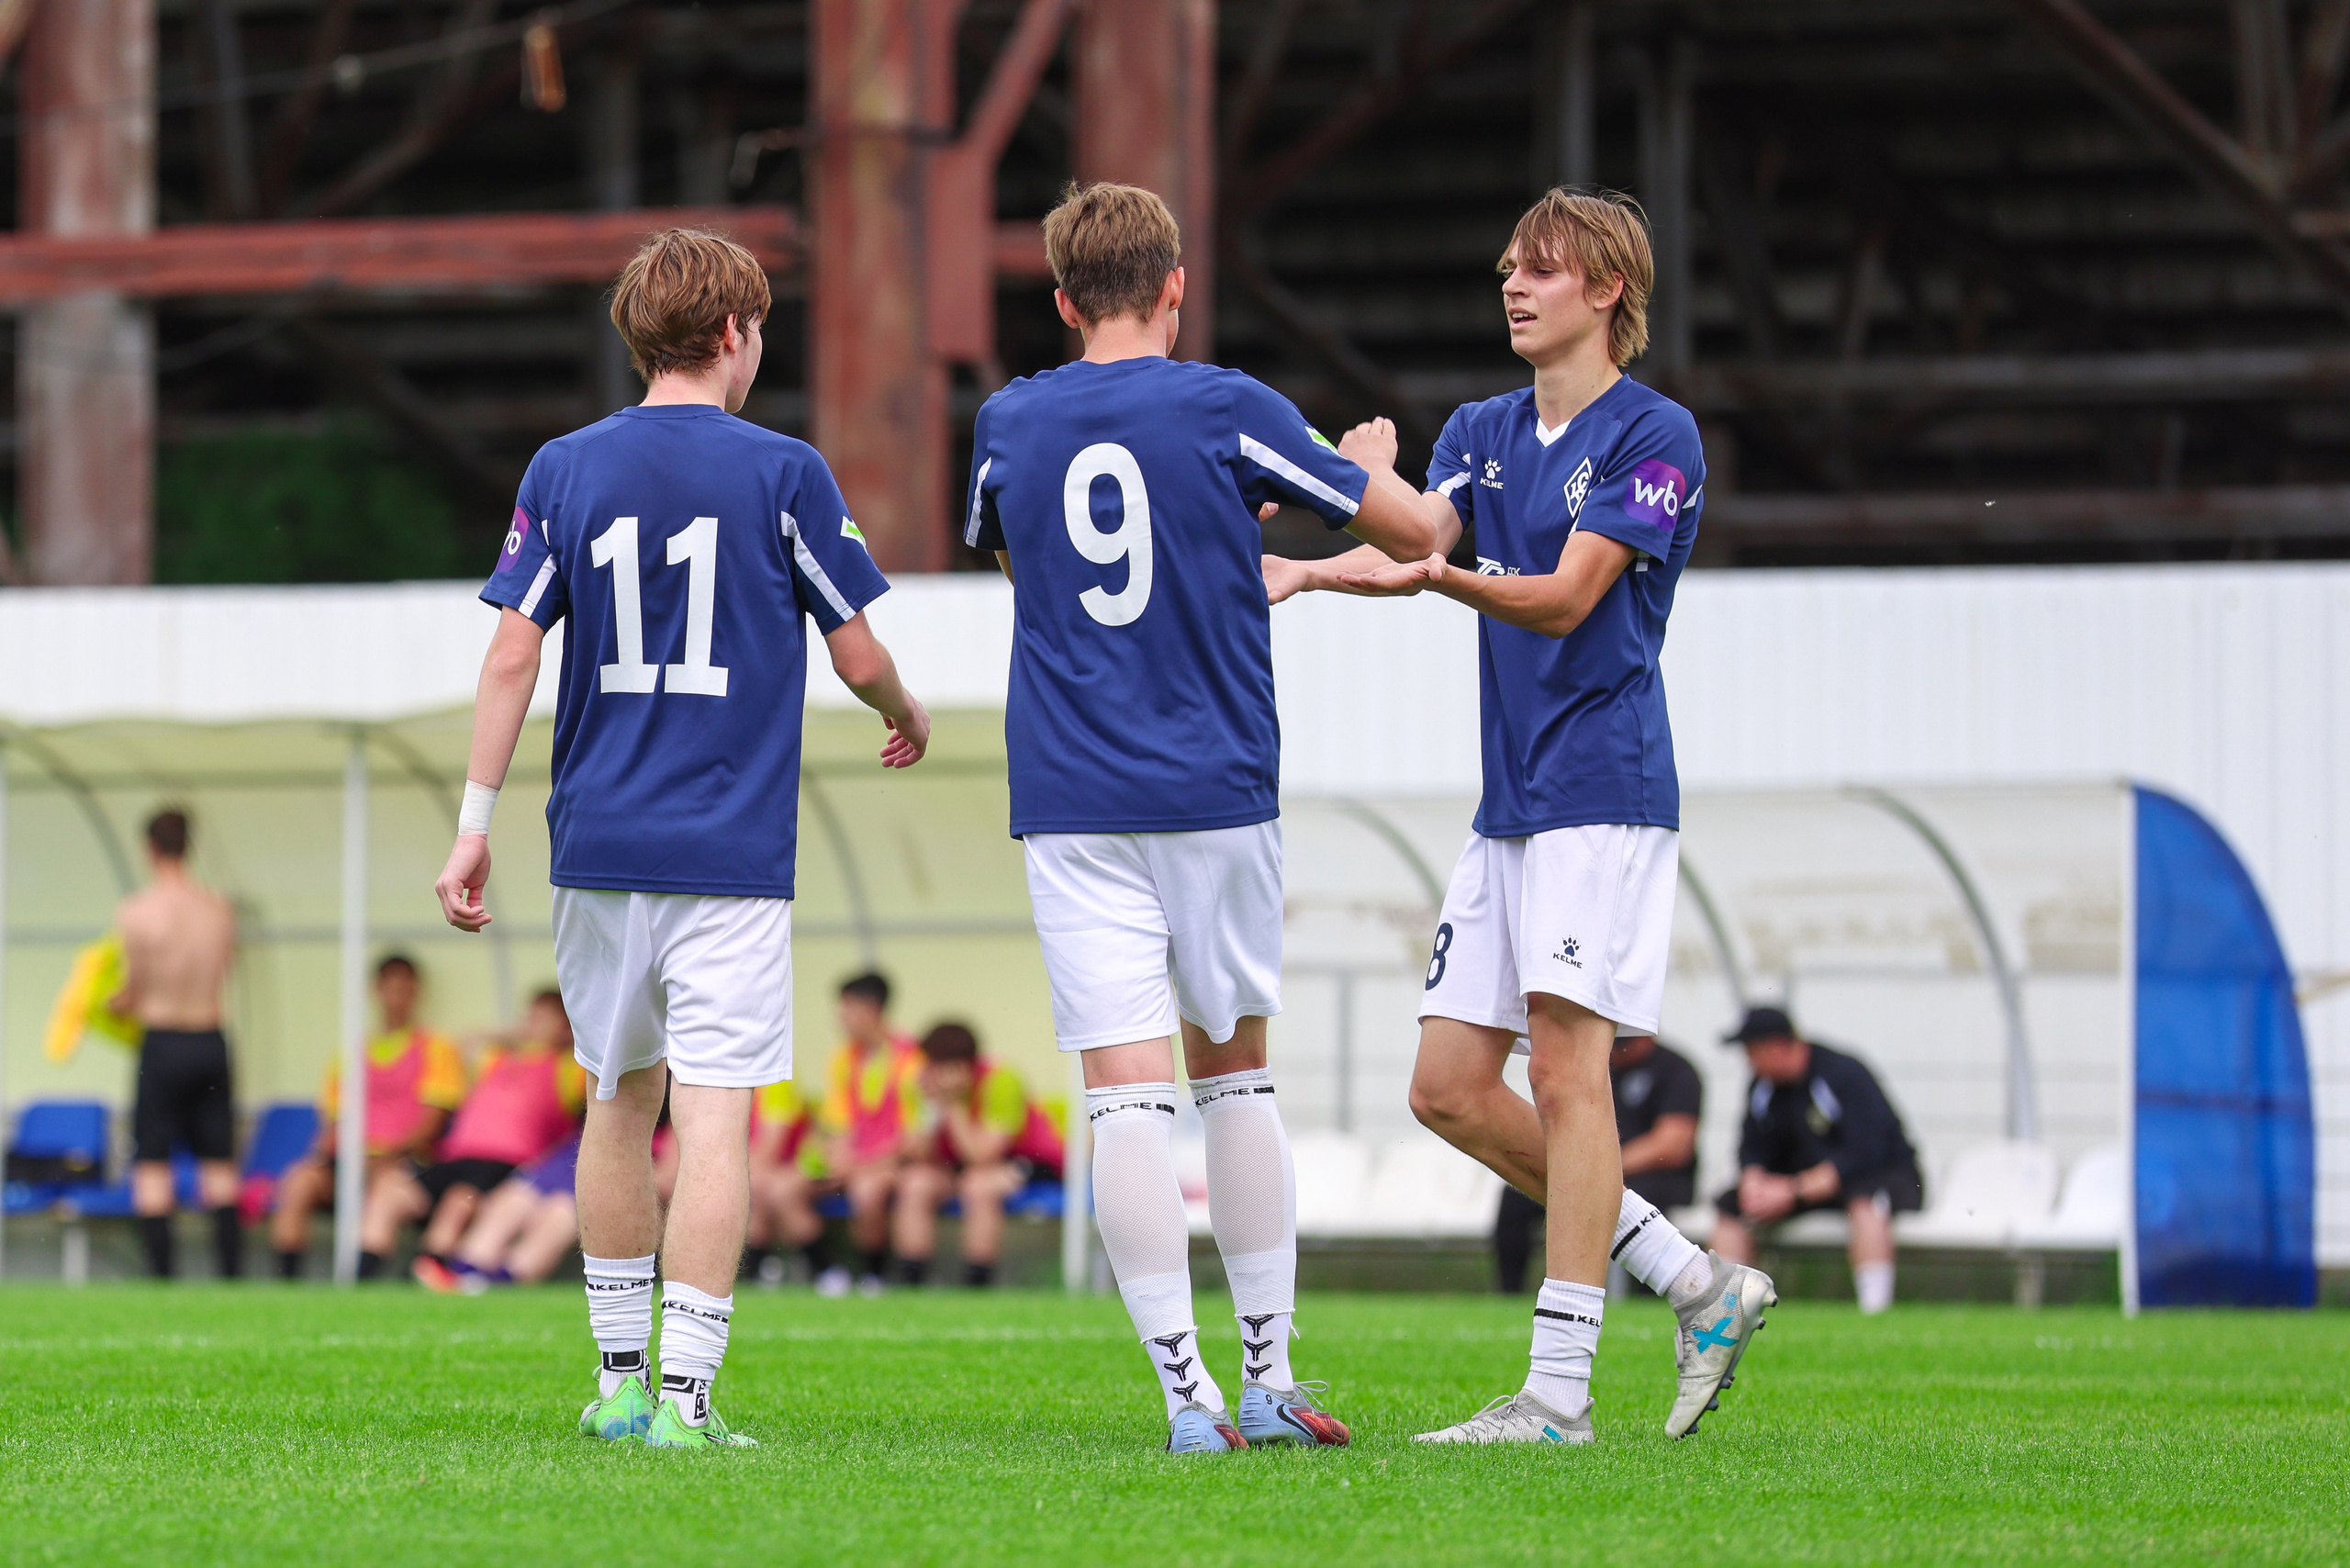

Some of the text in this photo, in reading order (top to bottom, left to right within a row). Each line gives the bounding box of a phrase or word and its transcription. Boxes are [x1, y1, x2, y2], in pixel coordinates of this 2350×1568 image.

[1634, 476, 1678, 517] wb
[1063, 442, 1154, 627] 9
[590, 516, 729, 698] 11
[1425, 922, 1453, 991] 8
[1552, 952, 1583, 969] KELME
[1194, 1087, 1250, 1107] KELME
[1090, 1102, 1152, 1122] KELME
[596, 1278, 649, 1292] KELME
[1576, 1314, 1603, 1327] KEL
